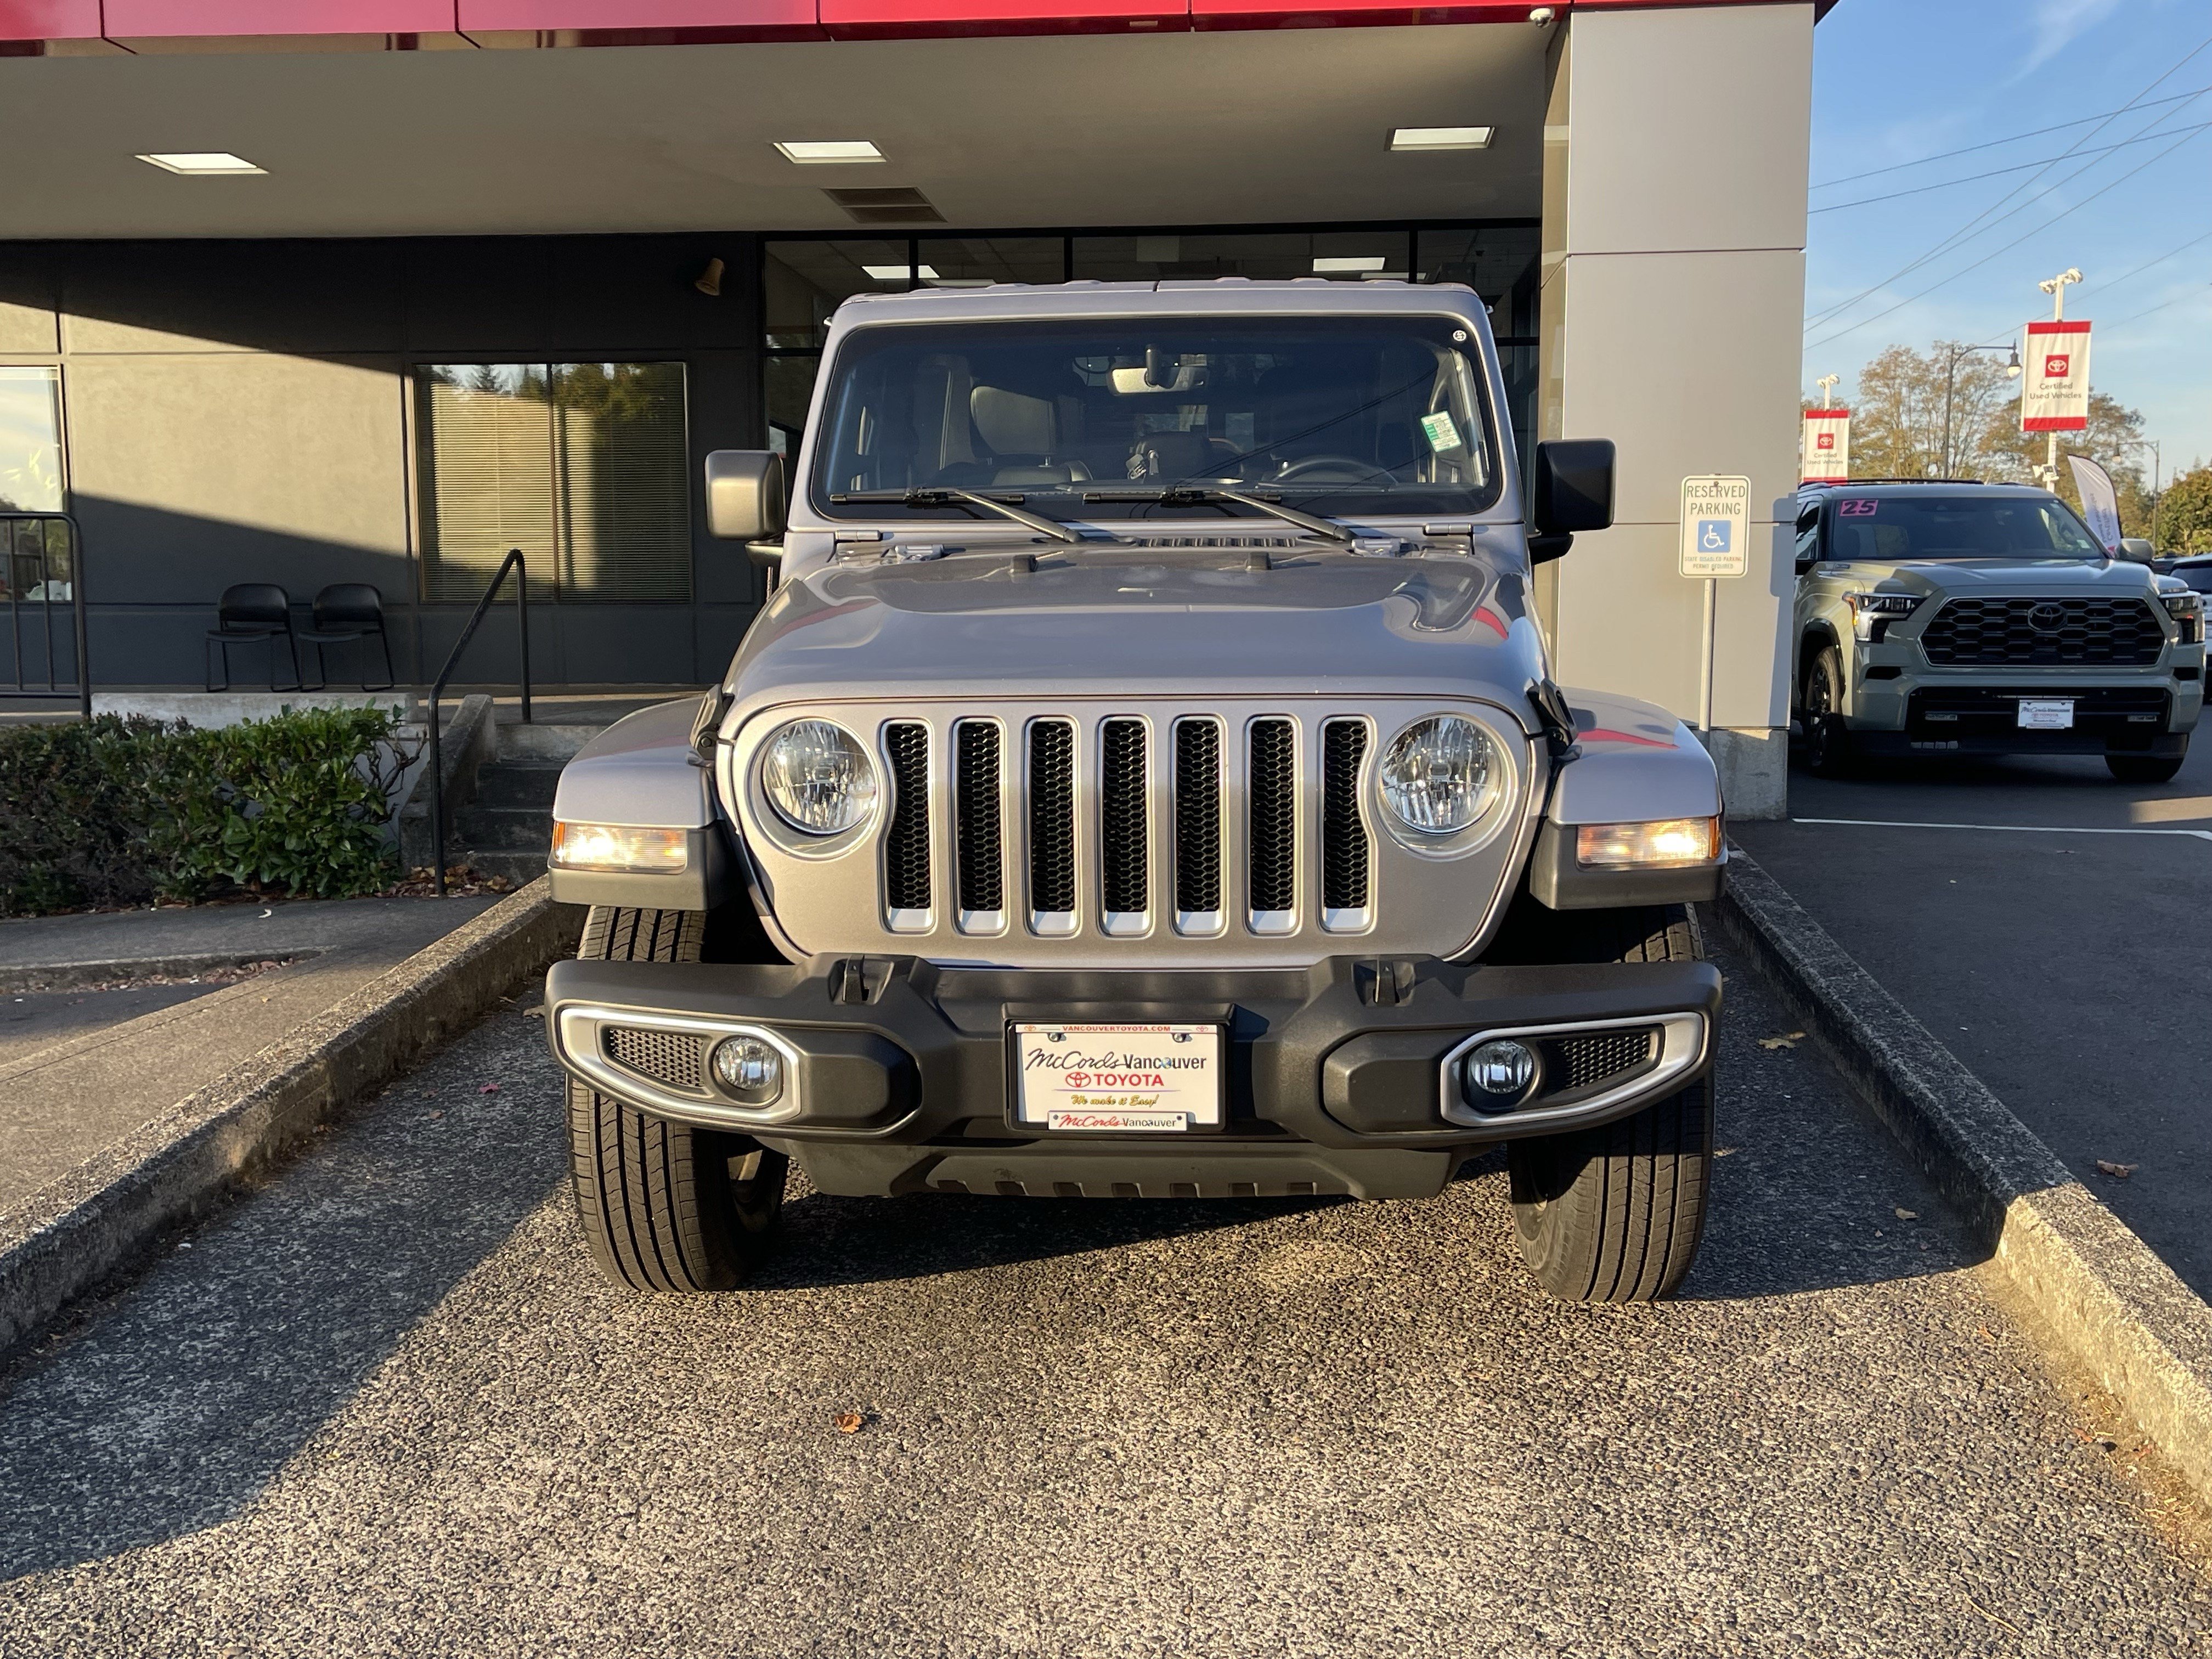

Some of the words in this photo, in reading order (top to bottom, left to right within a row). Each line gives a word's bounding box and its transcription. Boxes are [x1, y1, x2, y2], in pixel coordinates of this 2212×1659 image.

[1686, 486, 1746, 498] RESERVED
[1690, 503, 1741, 515] PARKING
[1842, 500, 1876, 514] 25
[1025, 1048, 1122, 1070] McCords
[1124, 1053, 1207, 1069] Vancouver
[1093, 1074, 1164, 1087] TOYOTA
[1071, 1094, 1088, 1104] We
[1090, 1096, 1116, 1105] make
[1129, 1094, 1159, 1107] Easy!
[1058, 1114, 1121, 1127] McCords
[1122, 1118, 1176, 1127] Vancouver
